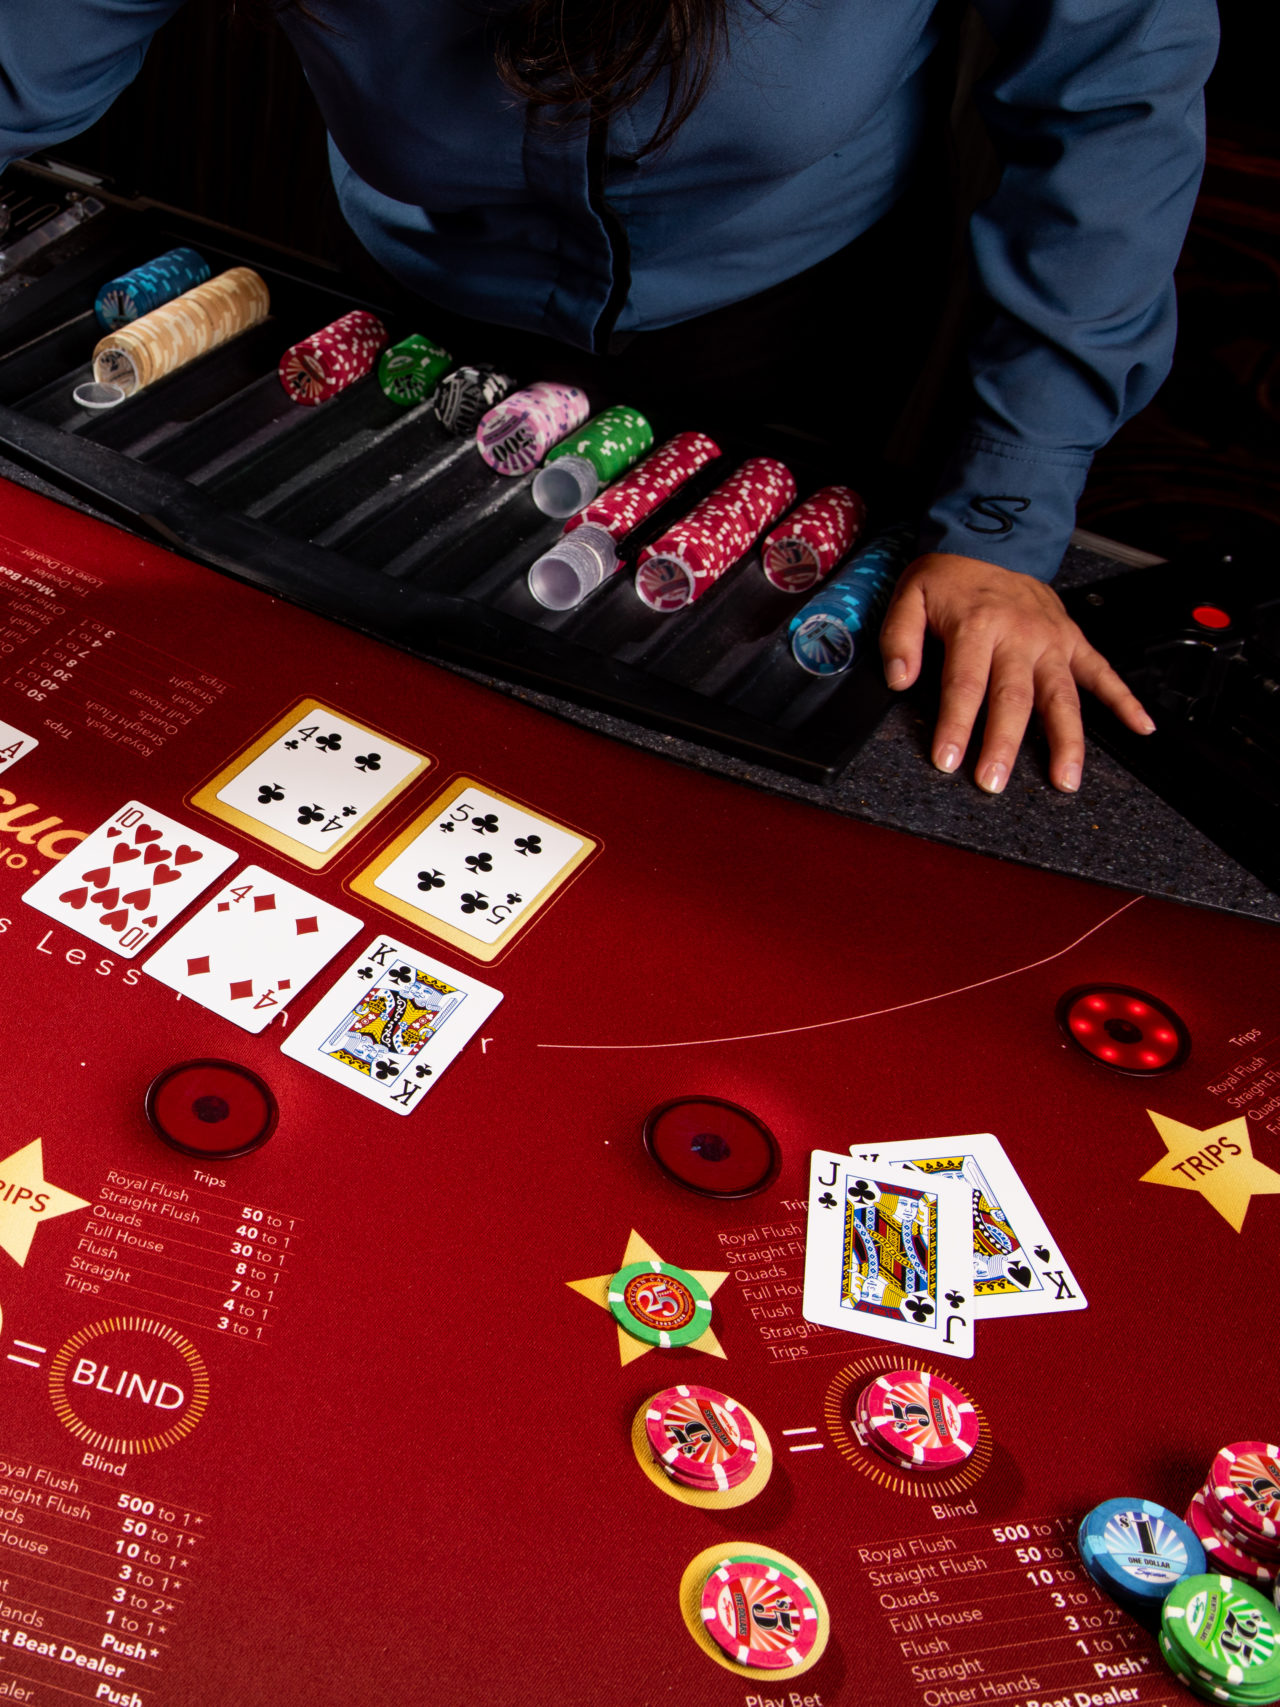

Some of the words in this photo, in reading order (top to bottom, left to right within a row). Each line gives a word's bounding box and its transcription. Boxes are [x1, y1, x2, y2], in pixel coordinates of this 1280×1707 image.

[43, 718, 73, 740] Trips
[297, 725, 320, 742] 4
[0, 740, 24, 758] A
[115, 807, 144, 828] 10
[320, 814, 345, 833] 4
[449, 803, 475, 822] 5
[229, 885, 254, 904] 4
[486, 905, 512, 926] 5
[118, 926, 150, 951] 10
[35, 930, 142, 986] Less
[367, 942, 398, 967] K
[253, 989, 279, 1010] 4
[1229, 1028, 1262, 1047] Trips
[1207, 1072, 1241, 1095] Royal
[1234, 1055, 1268, 1078] Flush
[390, 1079, 422, 1106] K
[1171, 1136, 1242, 1181] TRIPS
[193, 1170, 227, 1188] Trips
[818, 1162, 841, 1186] J
[107, 1170, 148, 1191] Royal
[150, 1182, 189, 1202] Flush
[241, 1207, 263, 1222] 50
[267, 1215, 282, 1227] to
[289, 1220, 295, 1231] 1
[99, 1187, 158, 1212] Straight
[160, 1203, 200, 1224] Flush
[235, 1225, 258, 1239] 40
[262, 1233, 277, 1245] to
[284, 1237, 290, 1249] 1
[93, 1205, 142, 1227] Quads
[230, 1242, 253, 1257] 30
[256, 1250, 271, 1263] to
[279, 1255, 285, 1266] 1
[1043, 1270, 1077, 1300] K
[637, 1283, 679, 1316] 25
[942, 1315, 967, 1345] J
[71, 1358, 185, 1411] BLIND
[705, 1409, 723, 1434] DOLLARS
[890, 1400, 930, 1430] $5
[932, 1398, 943, 1423] DOLLARS
[670, 1421, 712, 1454] $5
[719, 1434, 731, 1446] FIVE
[937, 1423, 947, 1436] FIVE
[82, 1452, 127, 1477] Blind
[34, 1469, 79, 1494] Flush
[117, 1494, 155, 1515] 500
[158, 1507, 175, 1522] to
[46, 1495, 91, 1521] Flush
[122, 1518, 147, 1536] 50
[151, 1528, 168, 1543] to
[931, 1499, 978, 1520] Blind
[116, 1540, 140, 1558] 10
[144, 1550, 161, 1565] to
[858, 1542, 907, 1564] Royal
[908, 1535, 957, 1556] Flush
[992, 1524, 1030, 1543] 500
[1033, 1524, 1051, 1536] to
[1128, 1557, 1142, 1565] ONE
[1144, 1558, 1170, 1569] DOLLAR
[735, 1593, 744, 1606] FIVE
[880, 1587, 939, 1610] Quads
[738, 1606, 747, 1636] DOLLARS
[752, 1599, 794, 1633] $5
[1221, 1610, 1261, 1663] $25
[12, 1632, 57, 1658] Beat
[60, 1646, 125, 1680] Dealer
[95, 1683, 143, 1707] Push
